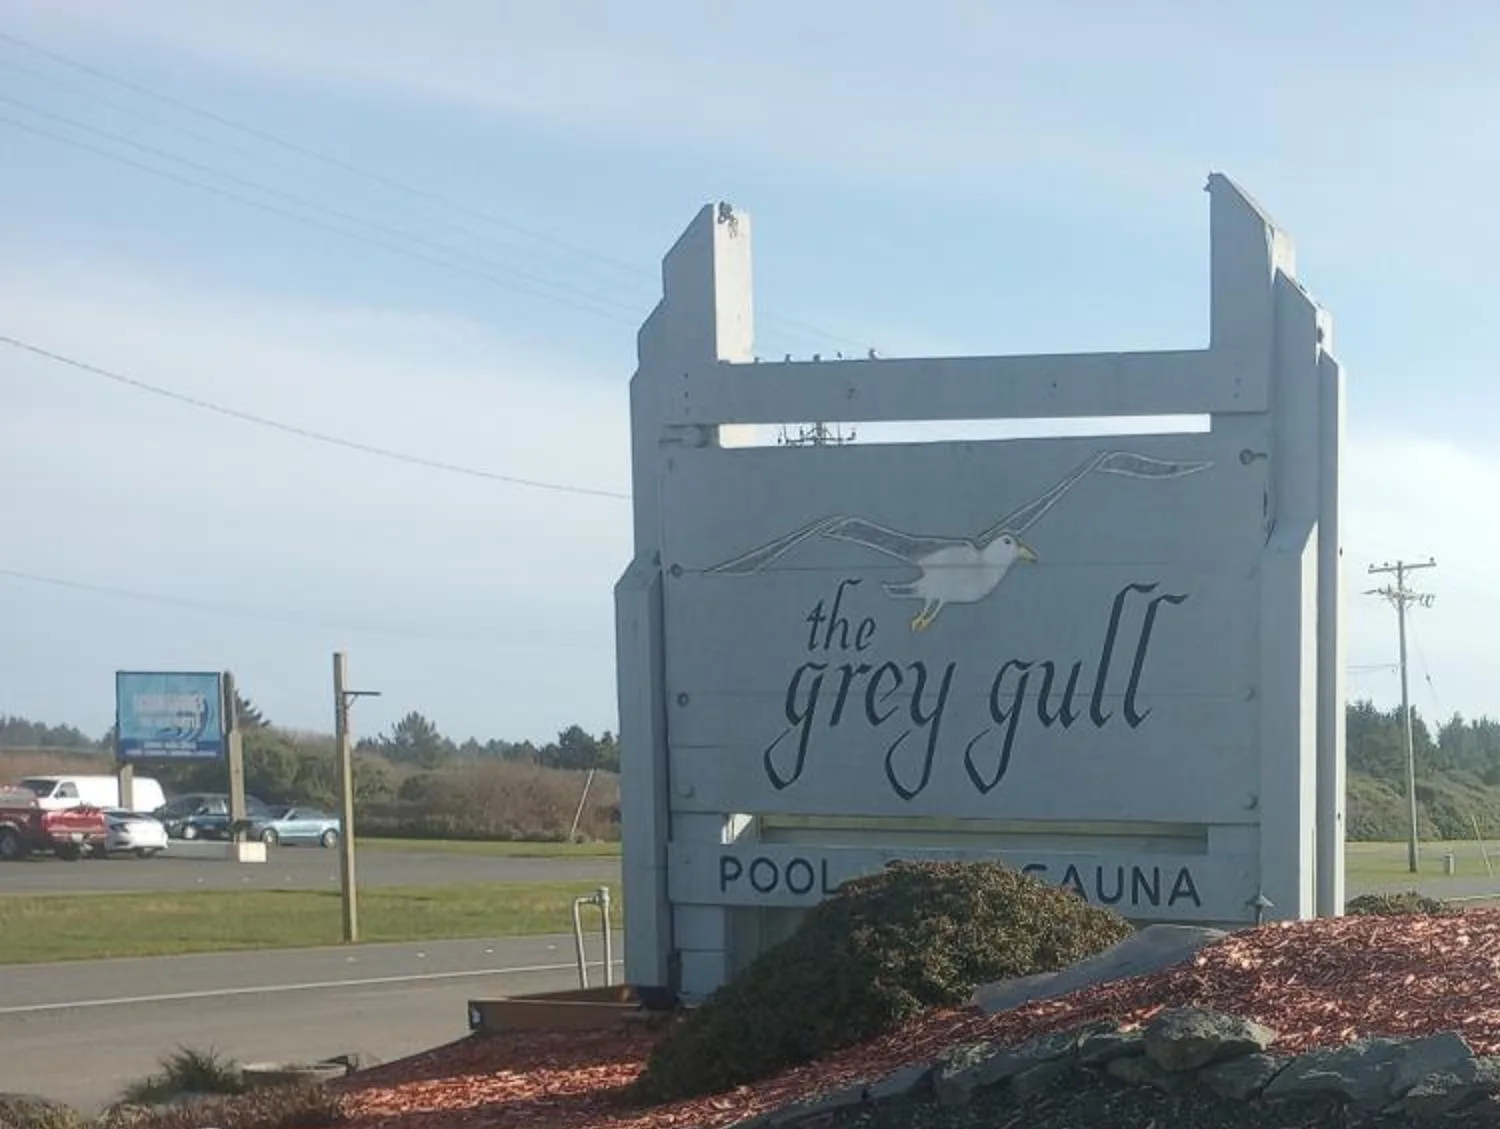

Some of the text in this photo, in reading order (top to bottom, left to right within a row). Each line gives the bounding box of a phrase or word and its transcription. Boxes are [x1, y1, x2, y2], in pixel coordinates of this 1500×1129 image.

[805, 579, 876, 651] the
[763, 582, 1190, 801] grey gull
[719, 856, 1201, 907] POOL AUNA
